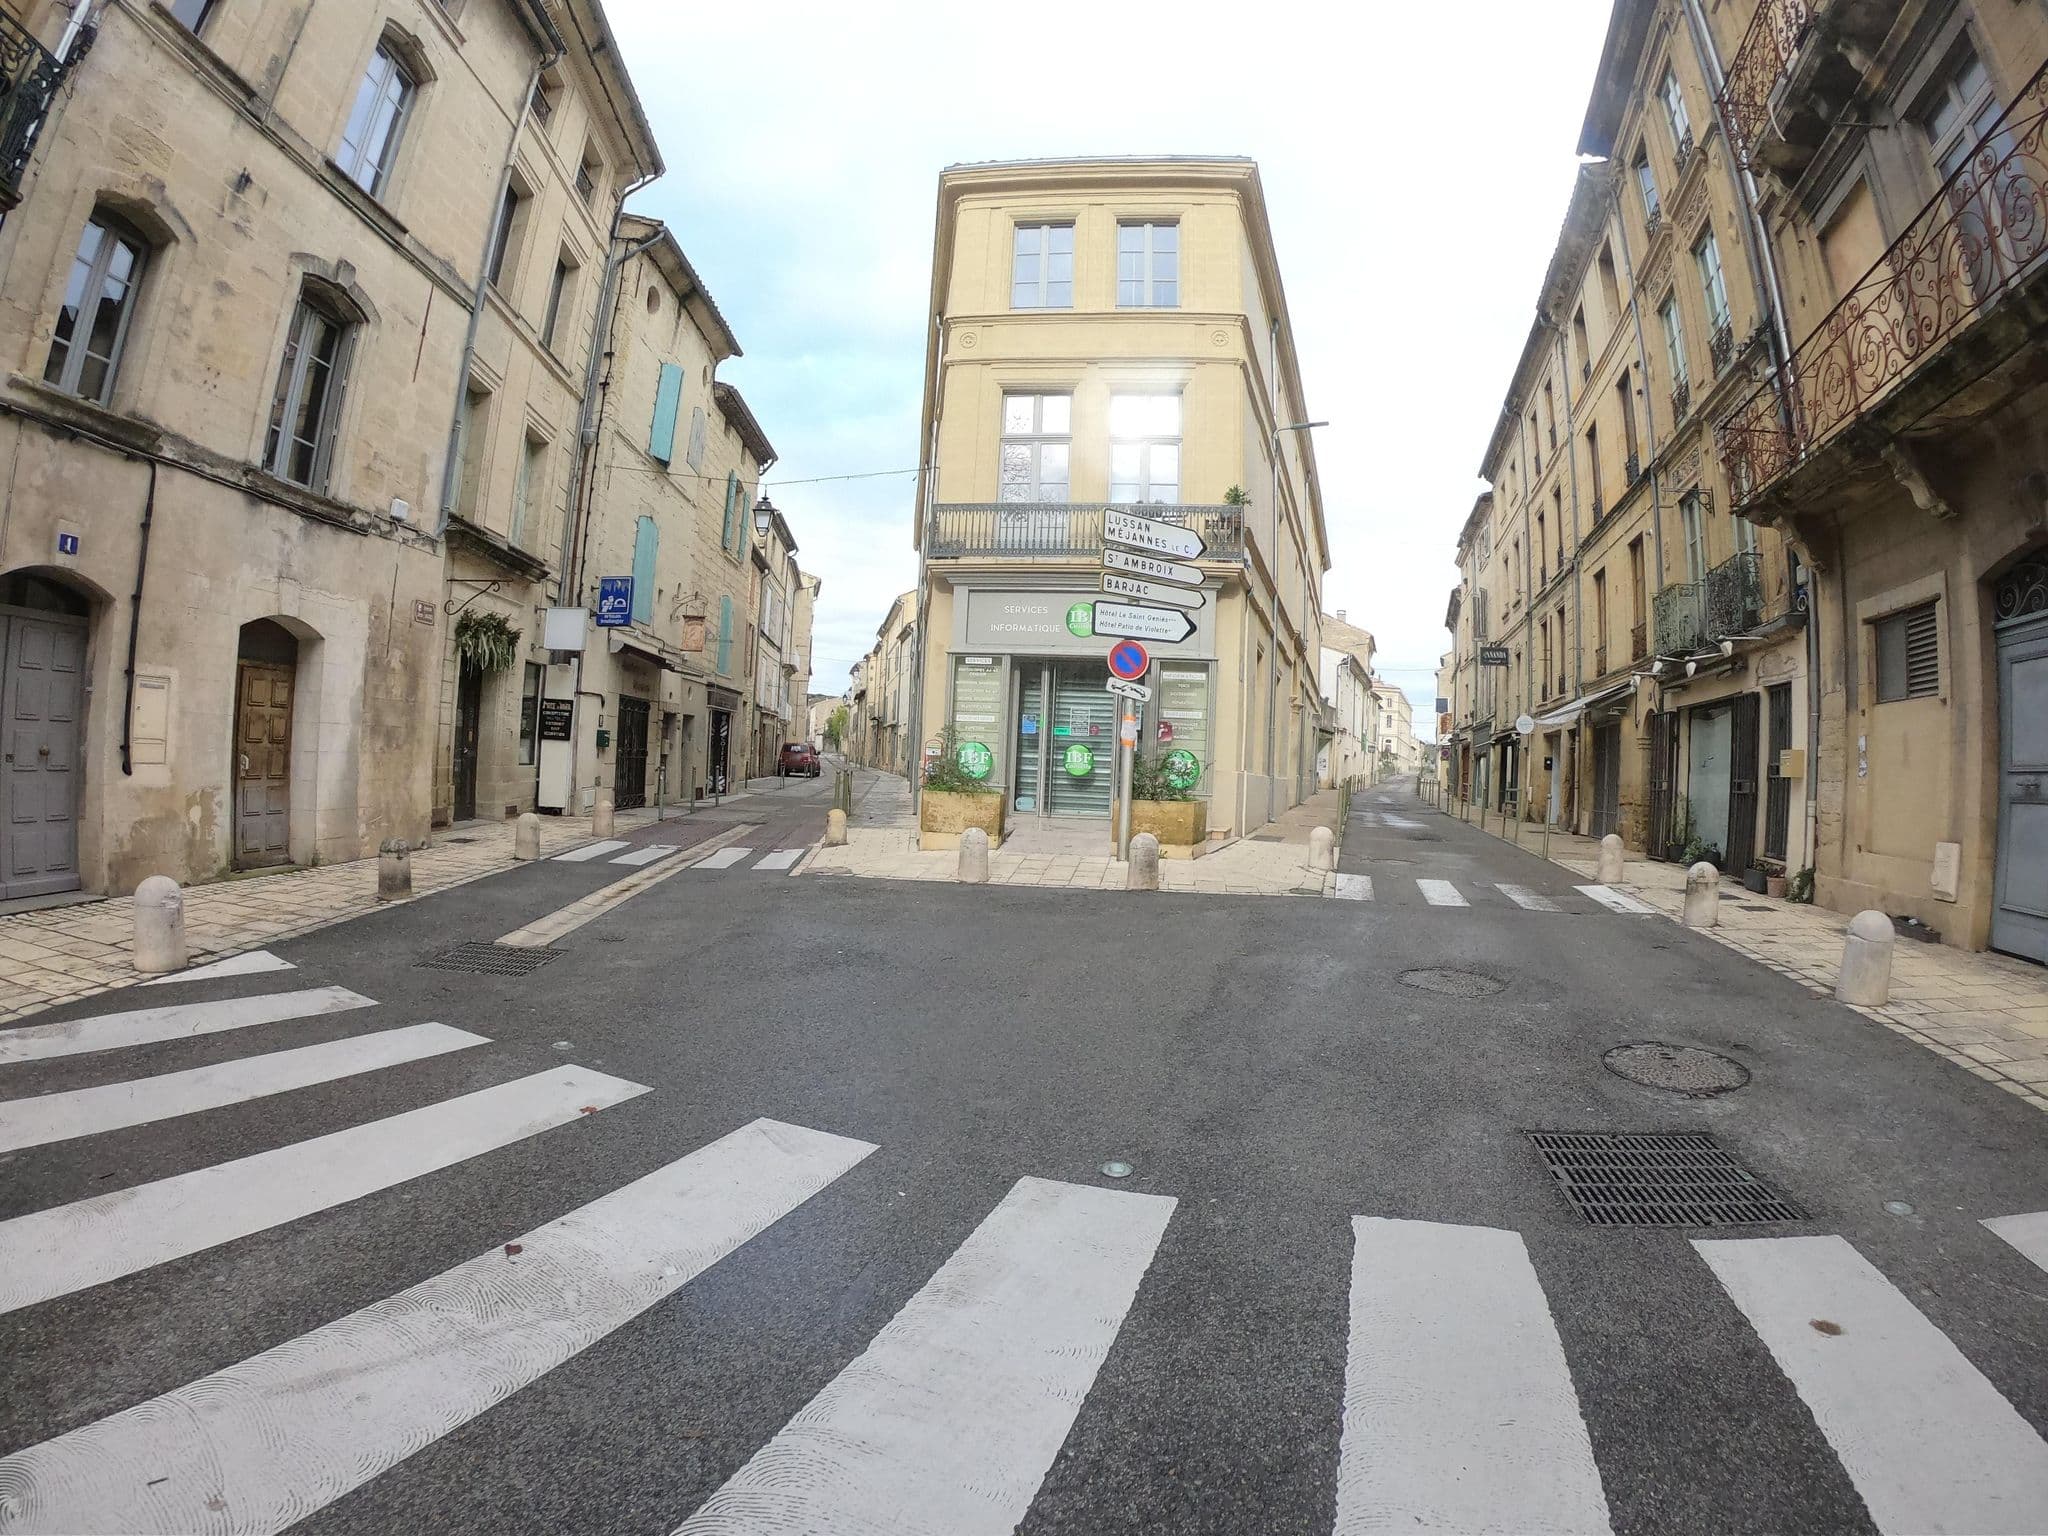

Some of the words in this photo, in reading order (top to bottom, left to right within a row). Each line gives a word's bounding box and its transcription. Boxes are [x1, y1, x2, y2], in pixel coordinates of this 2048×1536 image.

[1108, 514, 1151, 533] LUSSAN
[66, 536, 72, 551] 1
[1107, 526, 1167, 549] MÉJANNES
[1123, 557, 1174, 576] AMBROIX
[1106, 578, 1149, 595] BARJAC
[1003, 605, 1049, 614] SERVICES
[1069, 610, 1091, 623] IB
[1099, 608, 1118, 617] Hôtel
[1118, 610, 1127, 618] Le
[1127, 611, 1146, 620] Saint
[990, 623, 1061, 633] INFORMATIQUE
[1099, 620, 1117, 629] Hôtel
[1117, 622, 1134, 630] Patio
[1134, 624, 1143, 632] de
[1144, 625, 1169, 634] Violette
[1066, 751, 1093, 764] IBF
